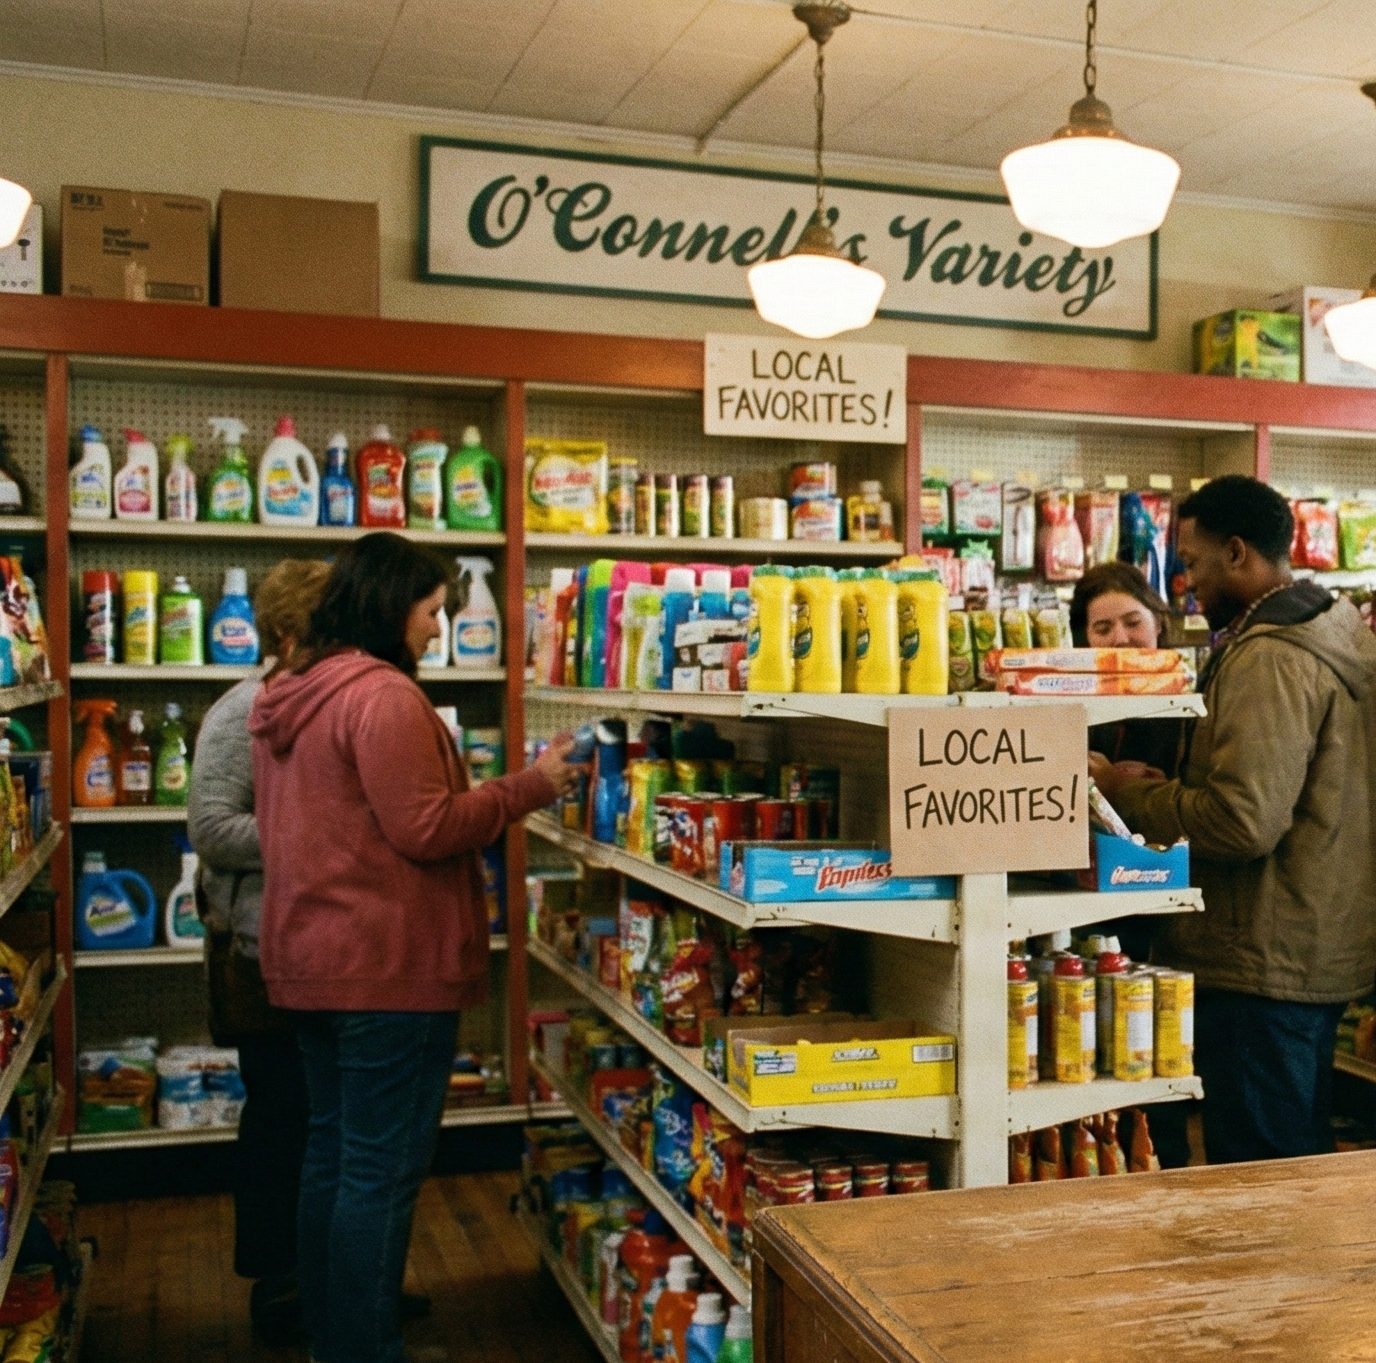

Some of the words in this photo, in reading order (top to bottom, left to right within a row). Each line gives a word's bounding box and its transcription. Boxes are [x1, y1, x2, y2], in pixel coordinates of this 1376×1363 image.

[890, 214, 1115, 318] Variety
[751, 348, 856, 386] LOCAL
[718, 387, 895, 429] FAVORITES!
[918, 728, 1045, 768] LOCAL
[904, 774, 1078, 830] FAVORITES!
